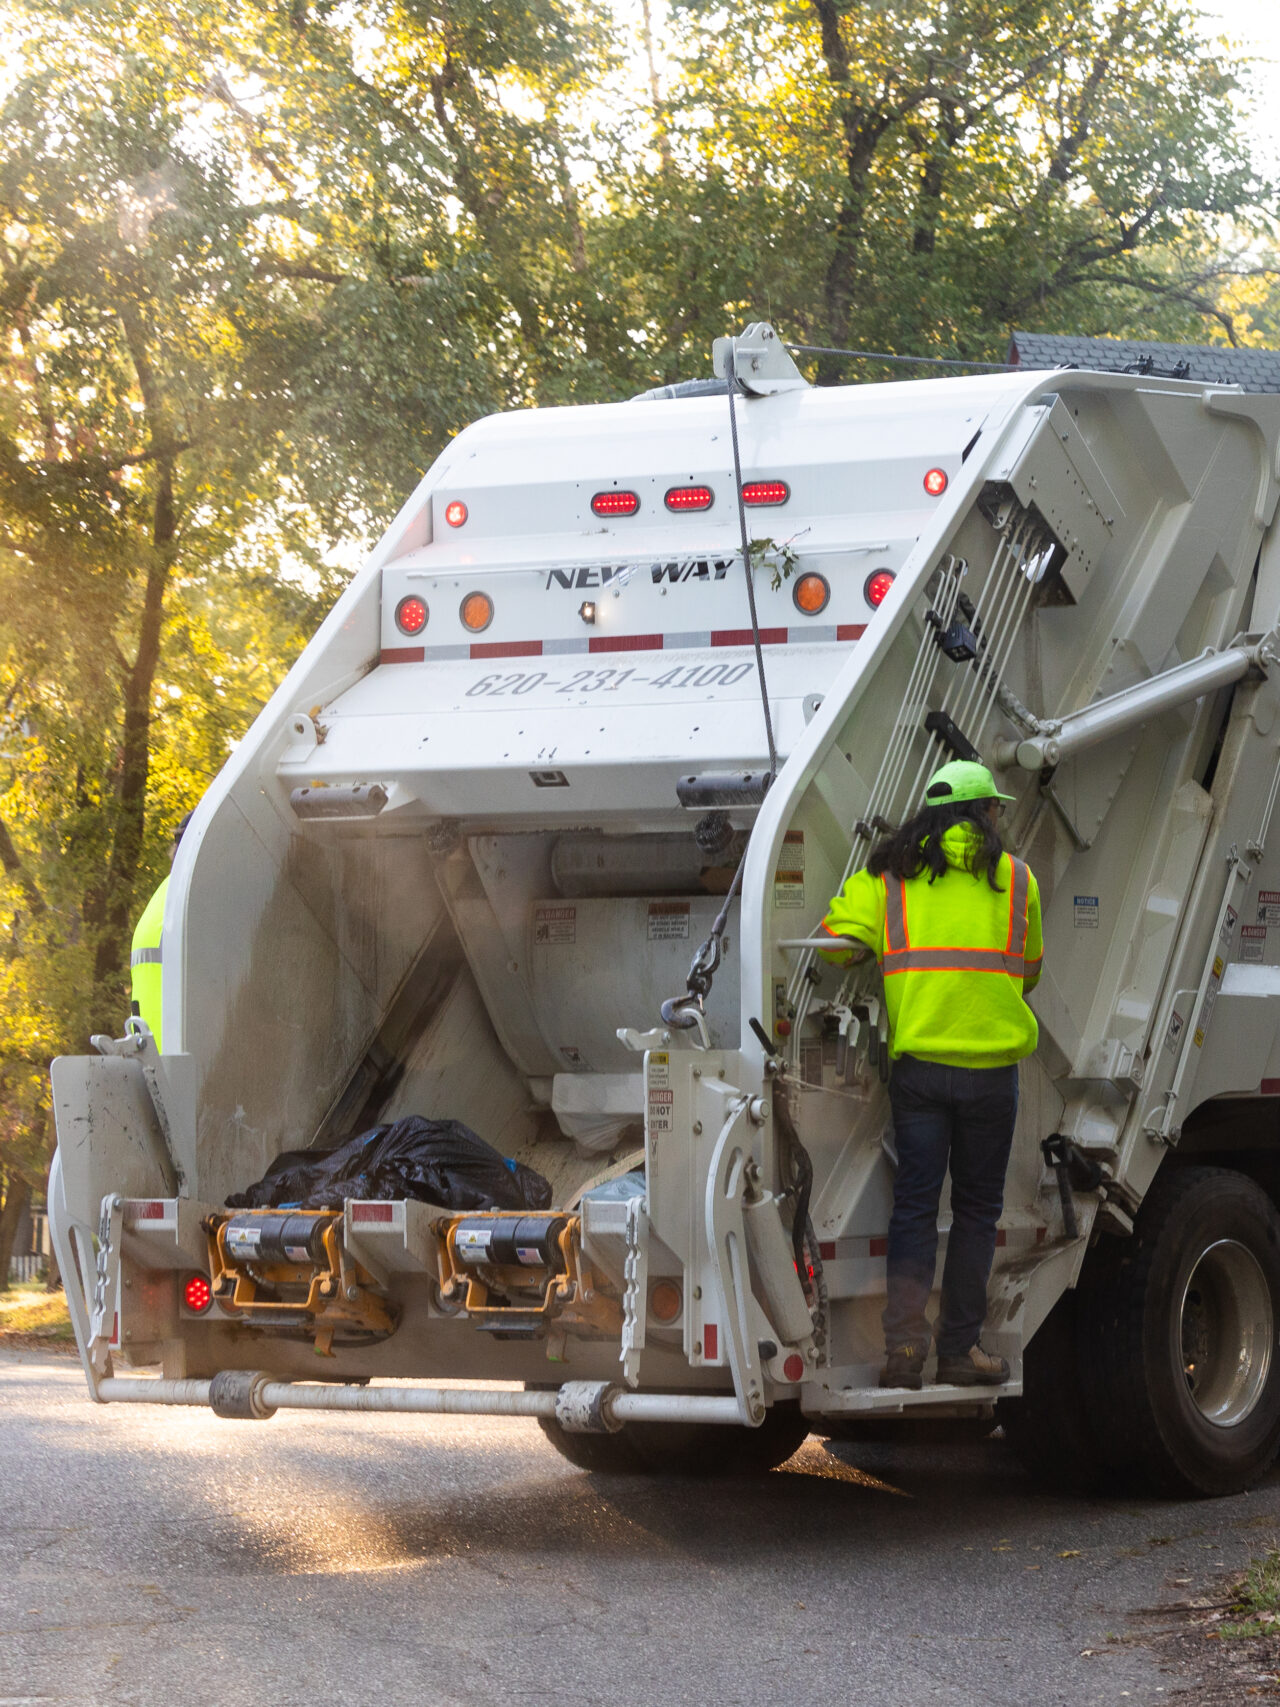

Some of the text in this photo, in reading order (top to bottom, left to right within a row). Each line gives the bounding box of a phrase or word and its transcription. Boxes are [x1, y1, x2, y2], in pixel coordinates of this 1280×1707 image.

[546, 559, 735, 590] NEW WAY
[465, 662, 754, 697] 620-231-4100
[1247, 928, 1266, 937] DANGER
